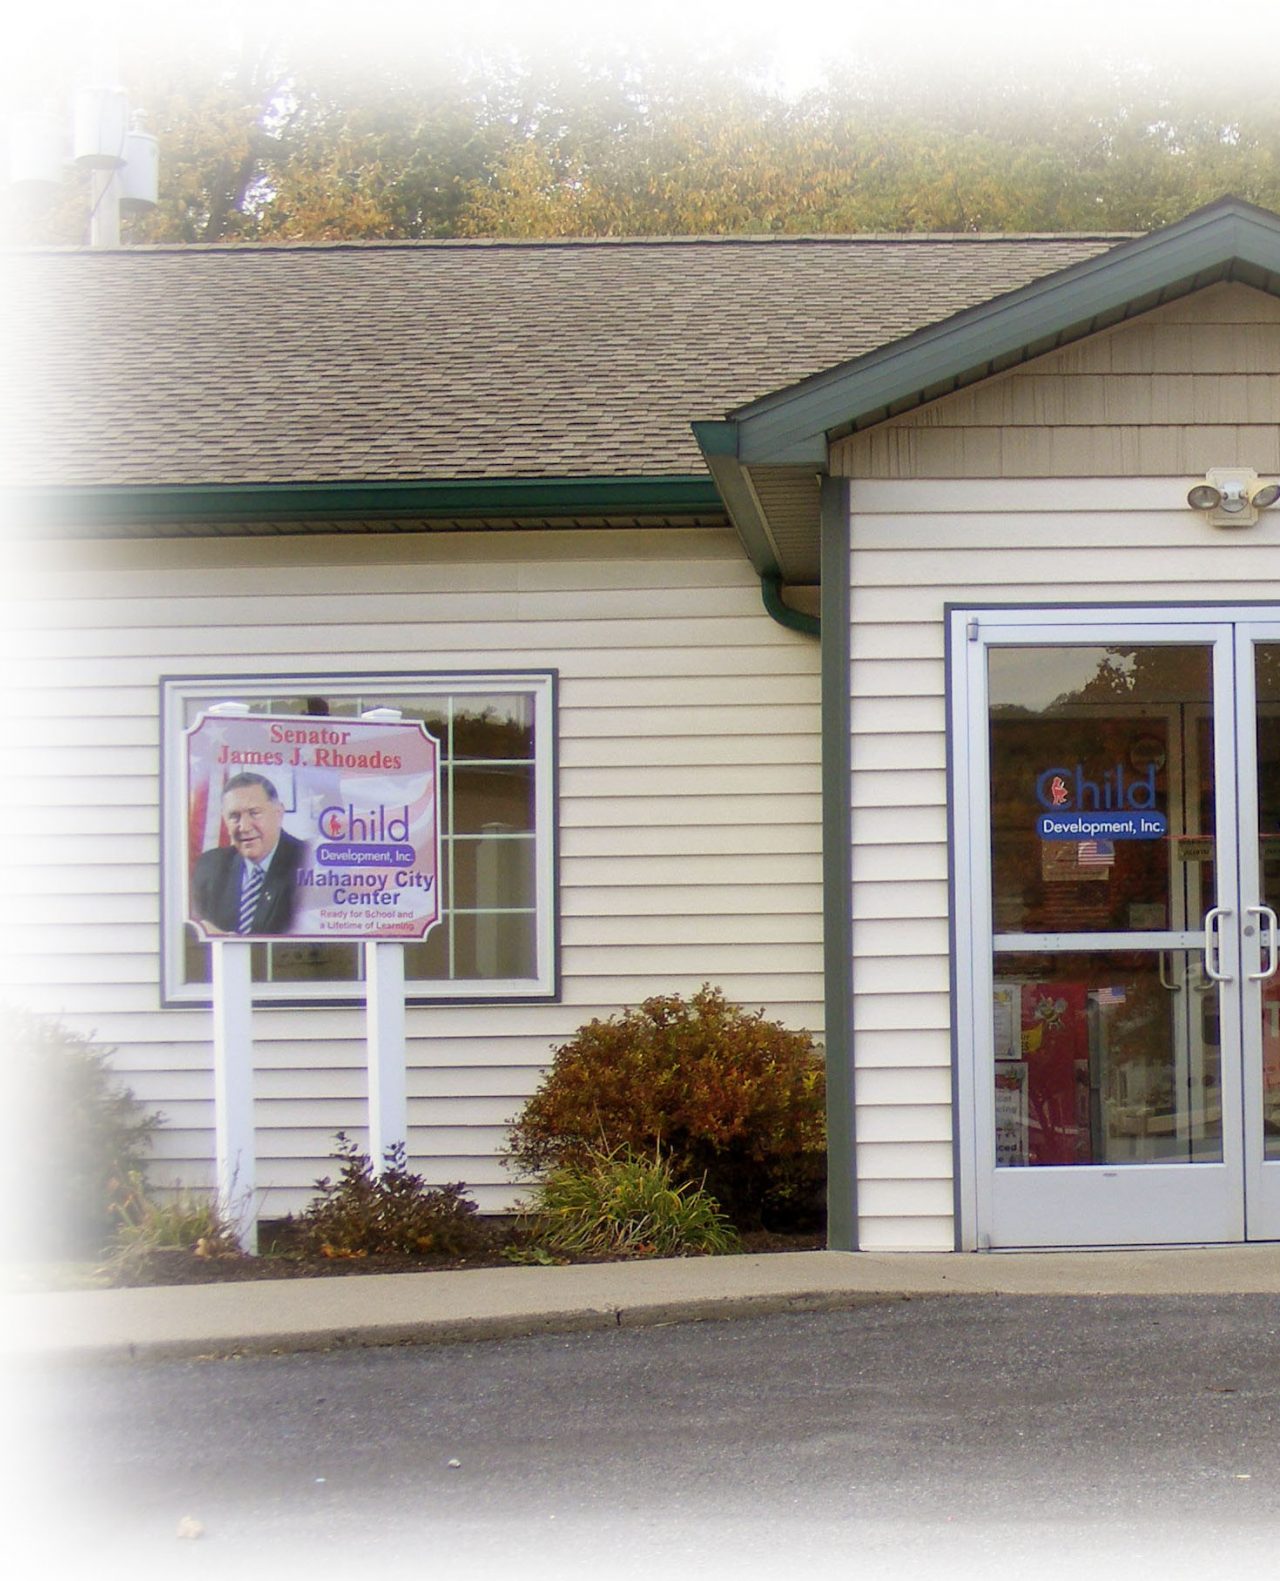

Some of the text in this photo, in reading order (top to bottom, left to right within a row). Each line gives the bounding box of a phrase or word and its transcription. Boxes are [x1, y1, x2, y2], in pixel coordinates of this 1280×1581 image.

[270, 724, 351, 745] Senator
[218, 745, 401, 769] James J. Rhoades
[1035, 763, 1157, 811] Child
[318, 803, 409, 842] Child
[1043, 818, 1164, 835] Development, Inc.
[321, 849, 393, 863] Development,
[297, 868, 434, 892] Mahanoy City
[333, 888, 401, 905] Center
[320, 909, 414, 919] Ready for School and
[327, 921, 364, 930] Lifetime
[365, 921, 374, 929] of
[376, 921, 415, 931] Learning
